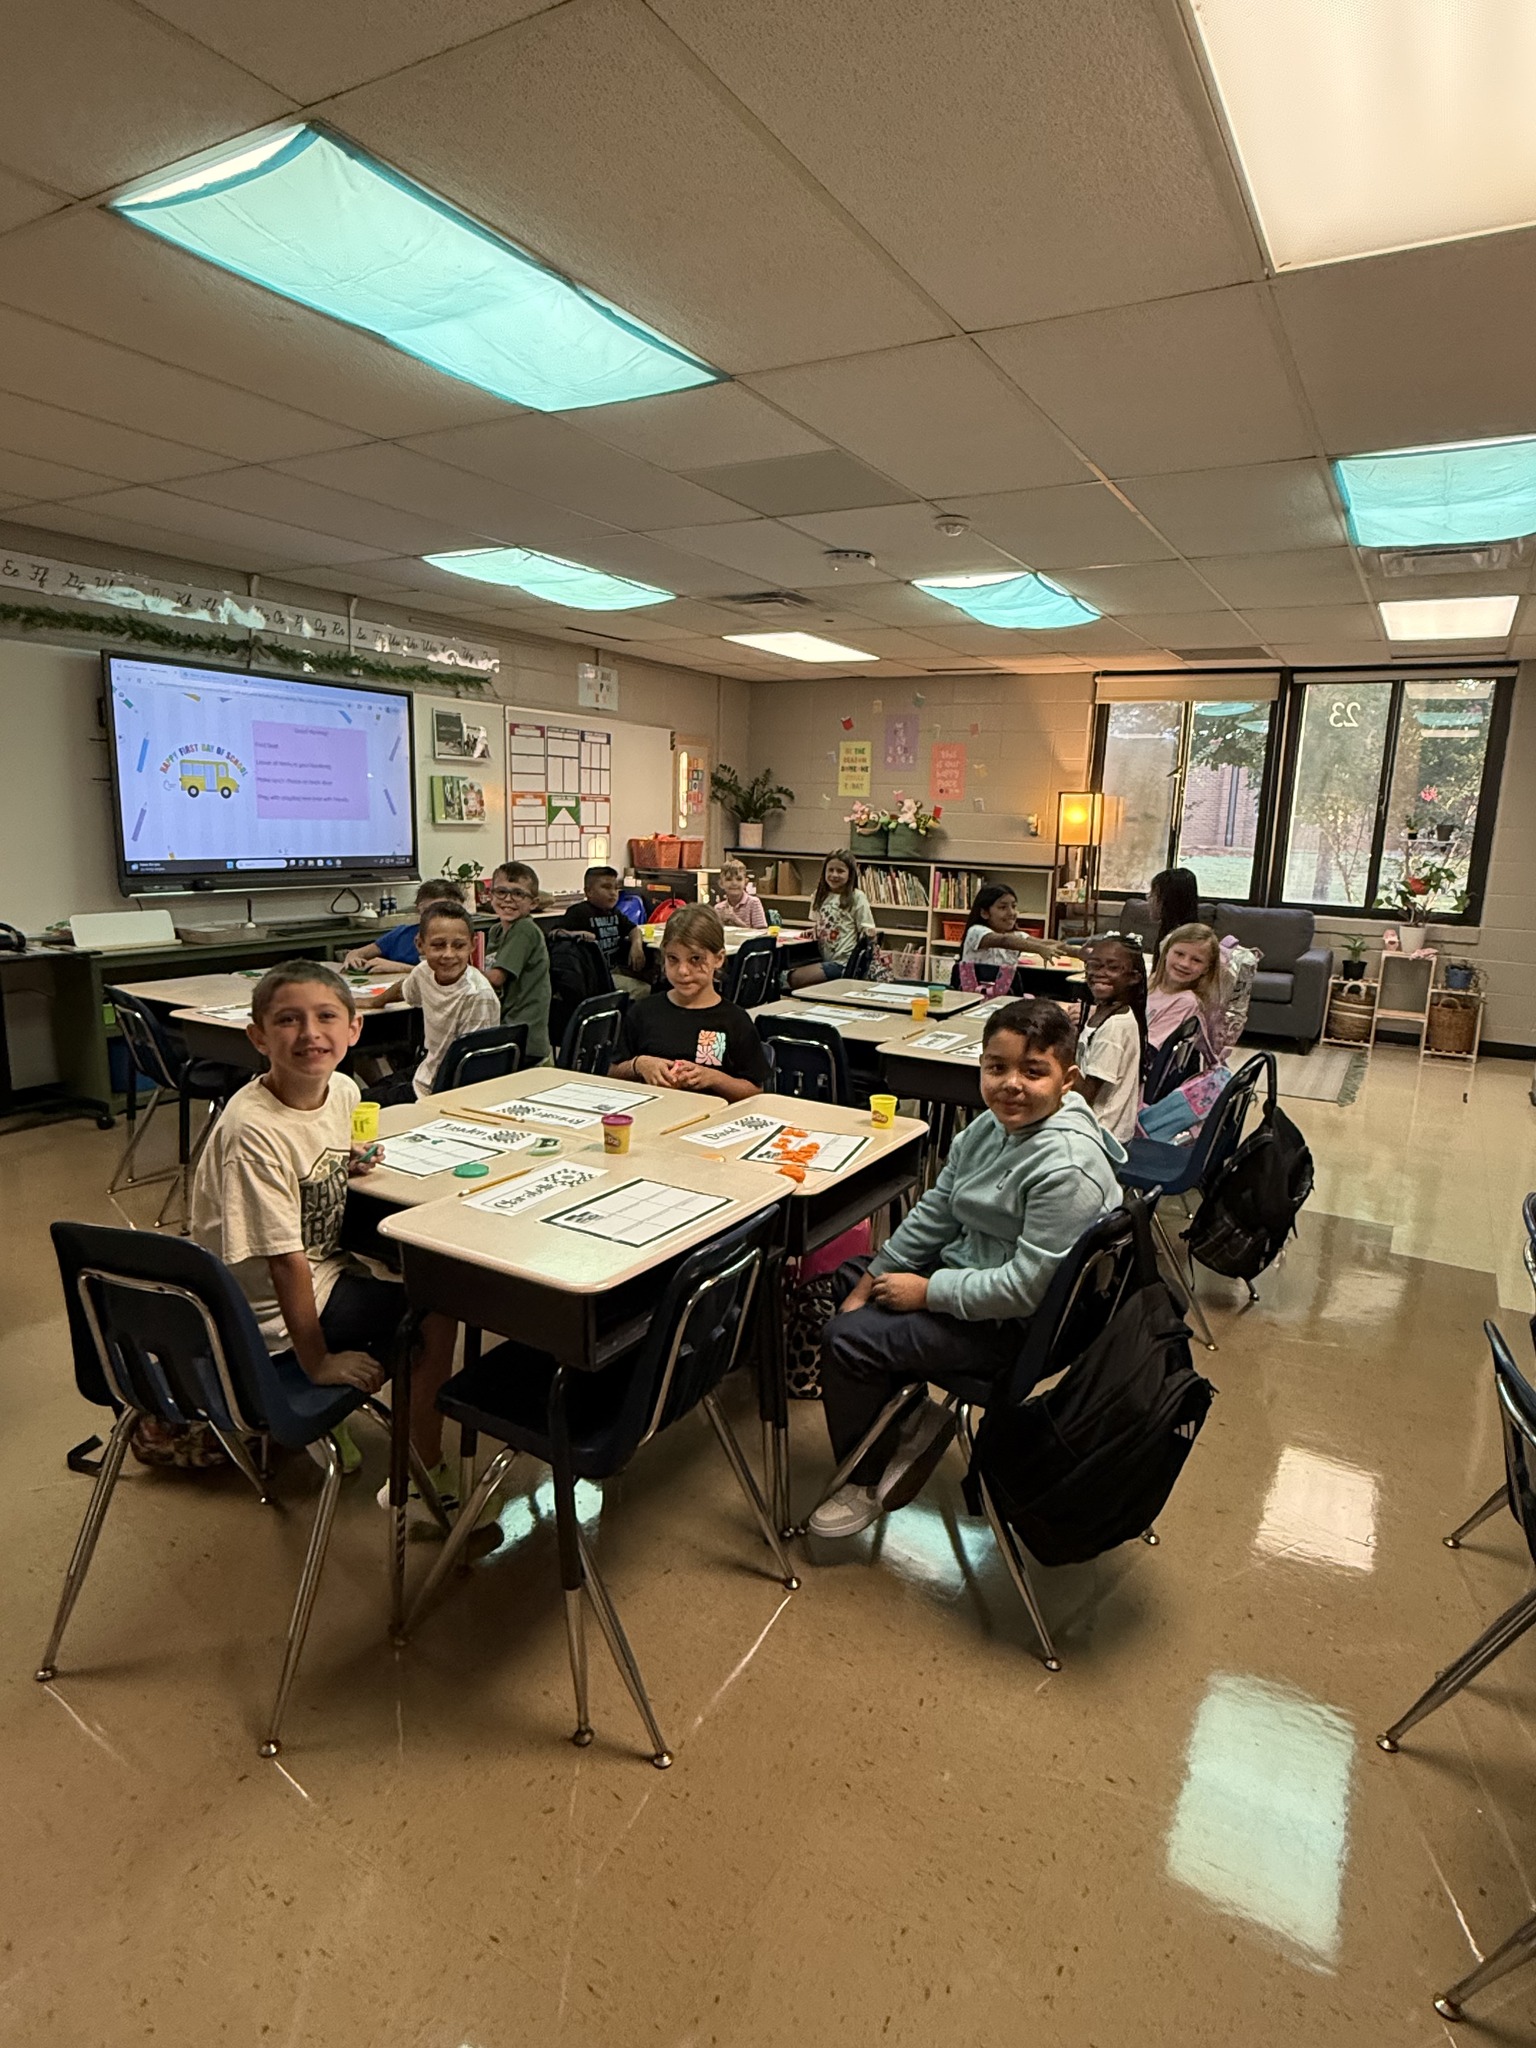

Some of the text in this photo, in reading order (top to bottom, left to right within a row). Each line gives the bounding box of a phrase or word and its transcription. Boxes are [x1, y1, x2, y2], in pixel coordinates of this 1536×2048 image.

[159, 751, 179, 774] HAPPY
[178, 743, 198, 756] FIRST
[201, 743, 215, 753] DAY
[216, 746, 225, 756] OF
